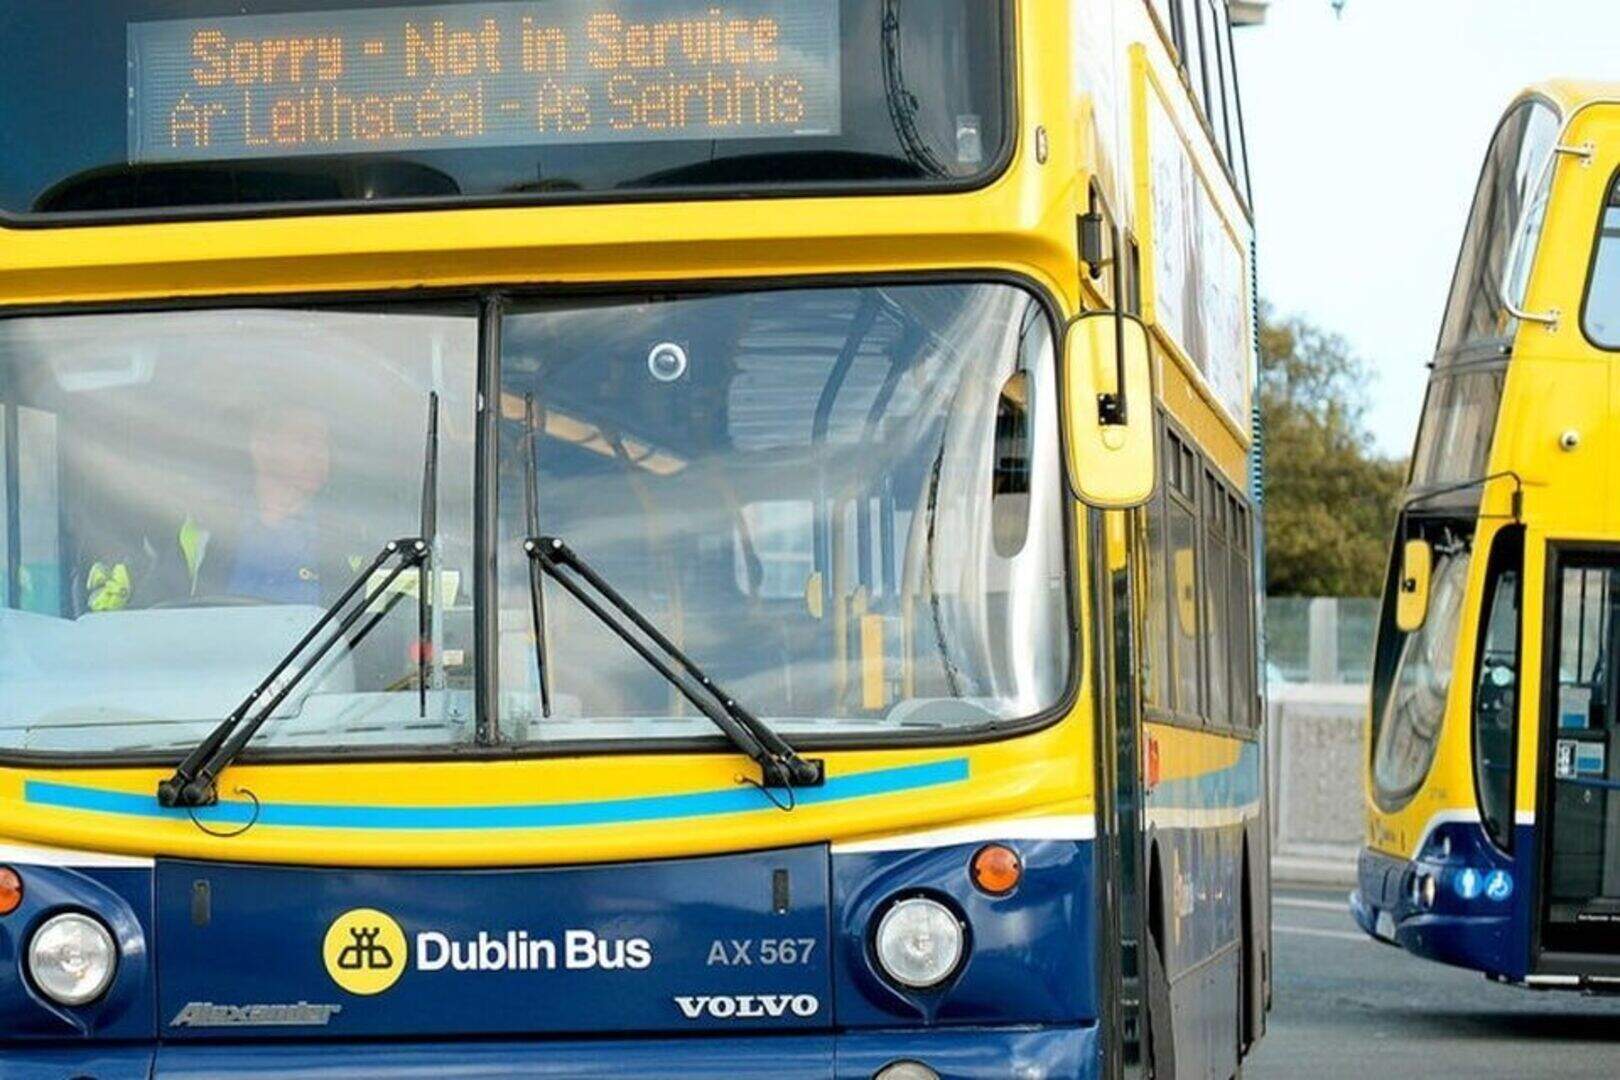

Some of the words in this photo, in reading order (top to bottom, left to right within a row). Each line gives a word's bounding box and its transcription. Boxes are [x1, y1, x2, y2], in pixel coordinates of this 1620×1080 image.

[192, 29, 343, 86] Sorry
[405, 18, 502, 77] Not
[522, 16, 567, 73] in
[587, 8, 779, 69] Service
[416, 930, 556, 971] Dublin
[564, 929, 652, 970] Bus
[706, 938, 752, 966] AX
[760, 937, 817, 965] 567
[674, 994, 819, 1018] VOLVO
